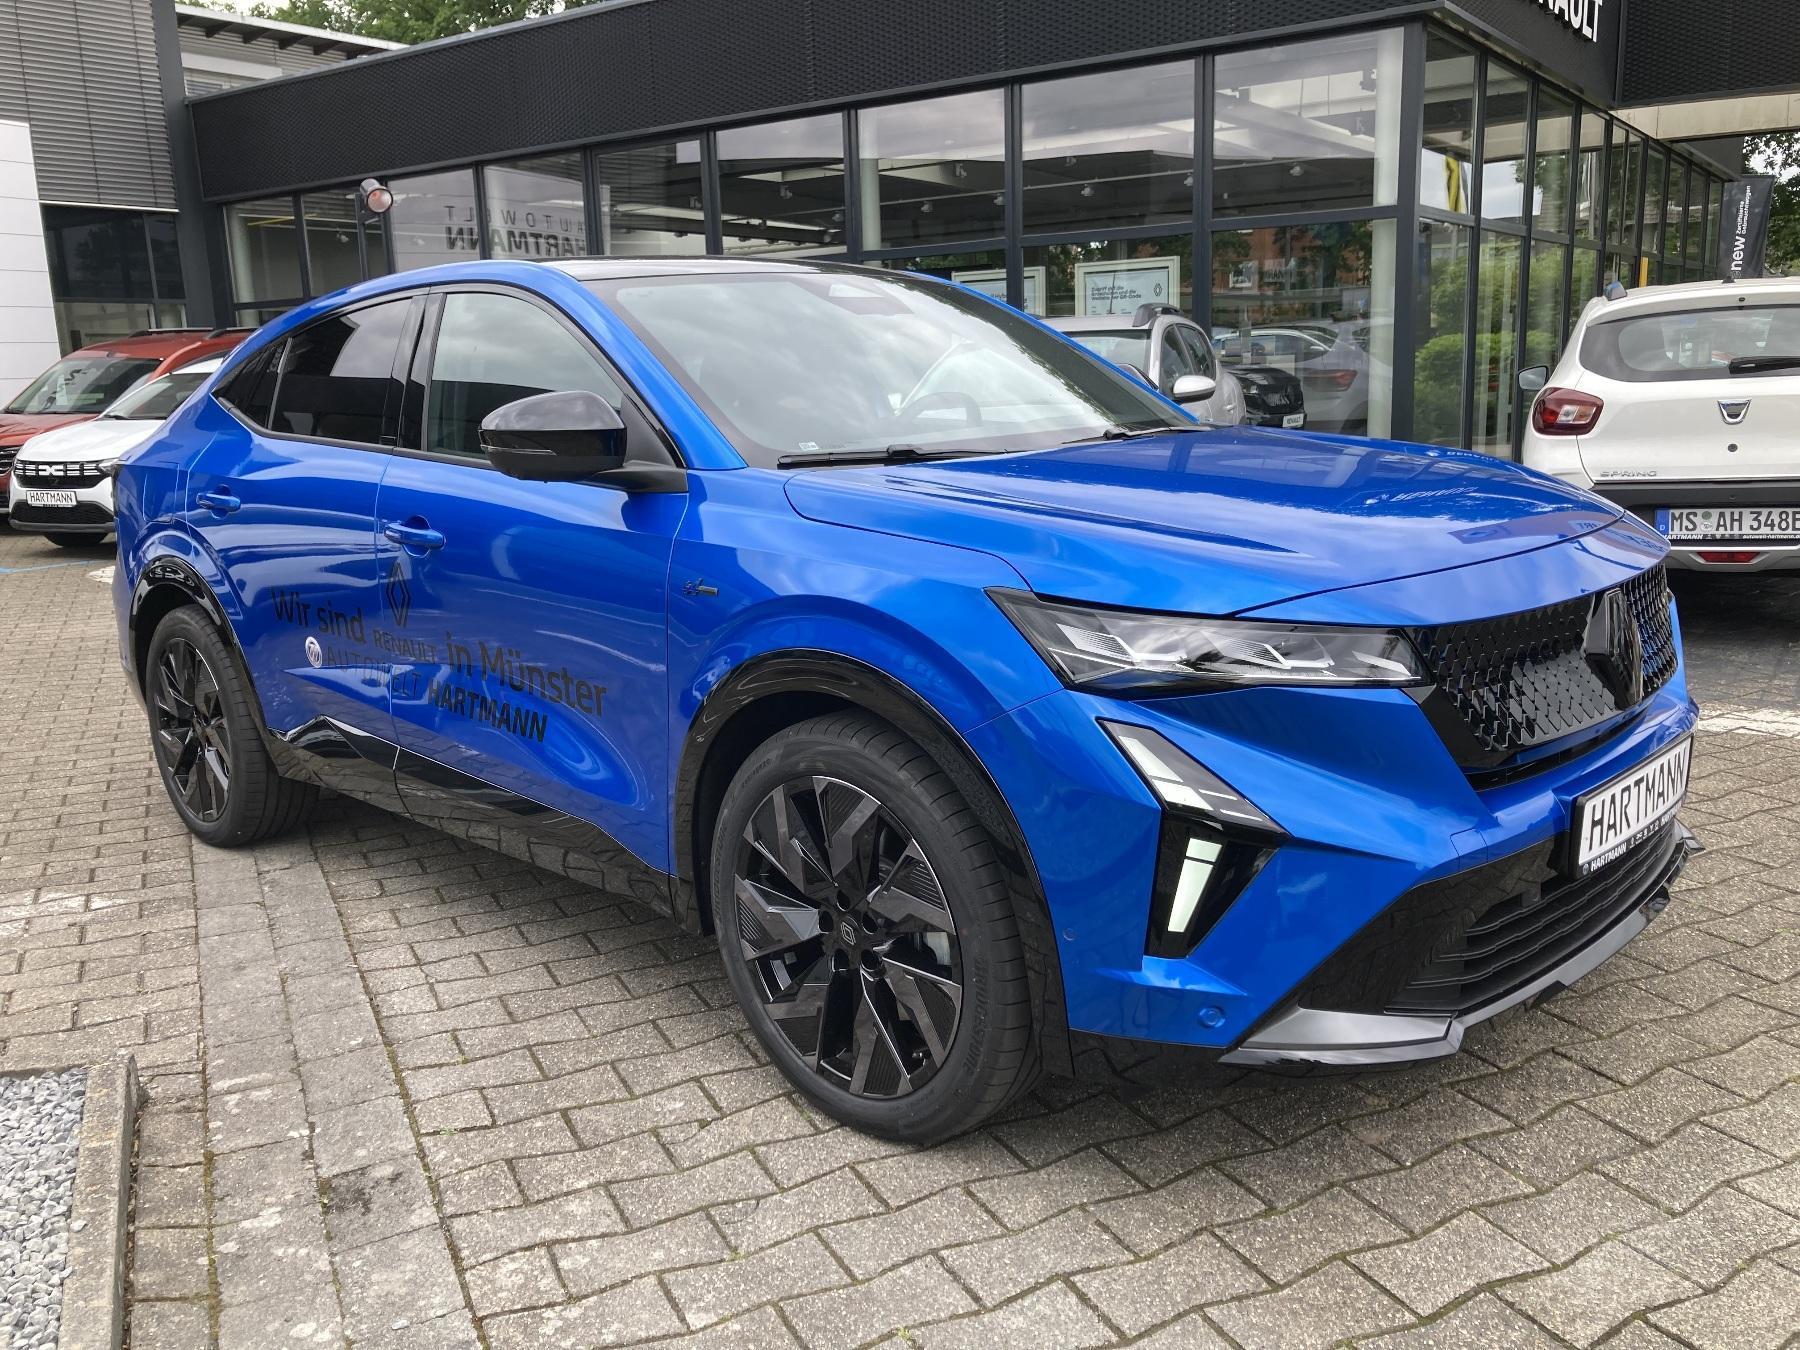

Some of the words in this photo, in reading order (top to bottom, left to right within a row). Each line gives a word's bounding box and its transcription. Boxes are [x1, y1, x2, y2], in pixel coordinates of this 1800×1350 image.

[30, 492, 73, 503] HARTMANN
[1671, 511, 1698, 532] MS
[1716, 511, 1743, 532] AH
[271, 586, 311, 627] Wir
[317, 600, 367, 645] sind
[373, 629, 438, 664] RENAULT
[446, 631, 472, 678] in
[478, 640, 608, 717] Münster
[428, 678, 548, 743] HARTMANN
[1588, 745, 1686, 853] HARTMANN
[1591, 842, 1627, 872] HARTMANN
